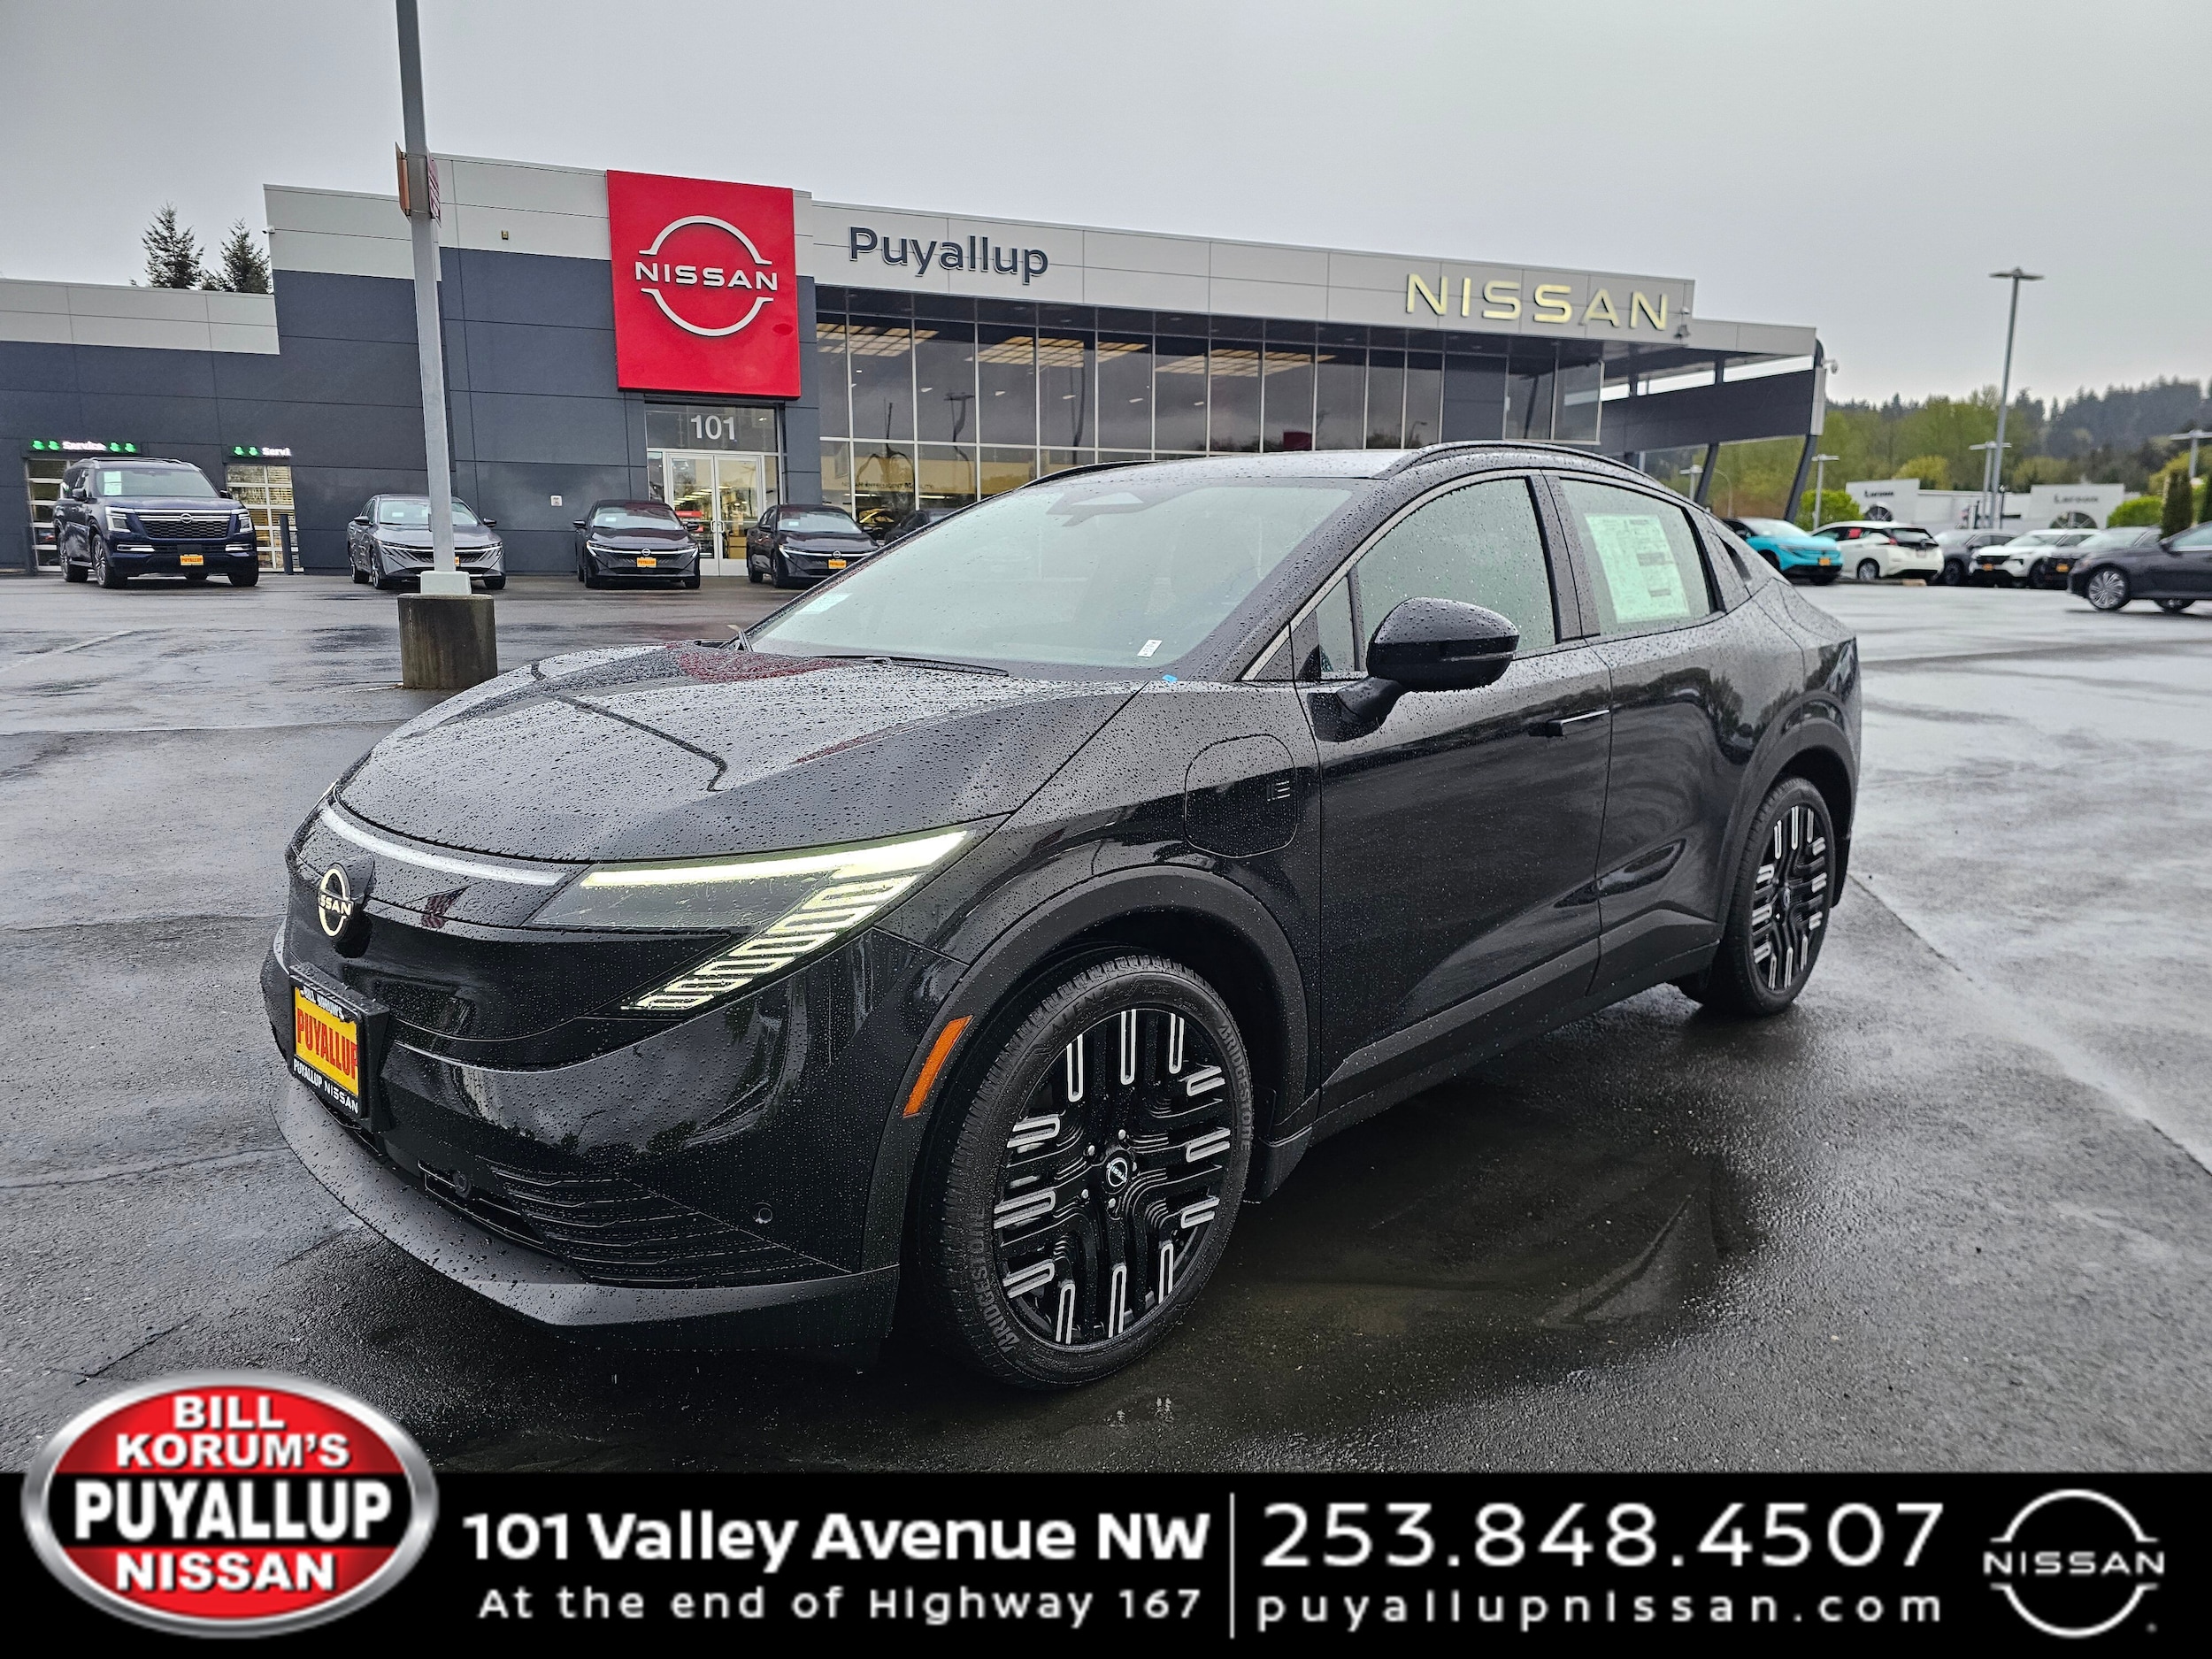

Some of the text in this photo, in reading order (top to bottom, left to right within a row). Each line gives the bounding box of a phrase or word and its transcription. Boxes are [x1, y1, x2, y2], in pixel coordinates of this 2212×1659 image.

[634, 261, 778, 291] NISSAN
[849, 227, 1048, 285] Puyallup
[1406, 273, 1669, 331] NISSAN
[690, 414, 735, 441] 101
[296, 1007, 358, 1080] PUYALLUP
[293, 1057, 358, 1115] PUYALLUP NISSAN
